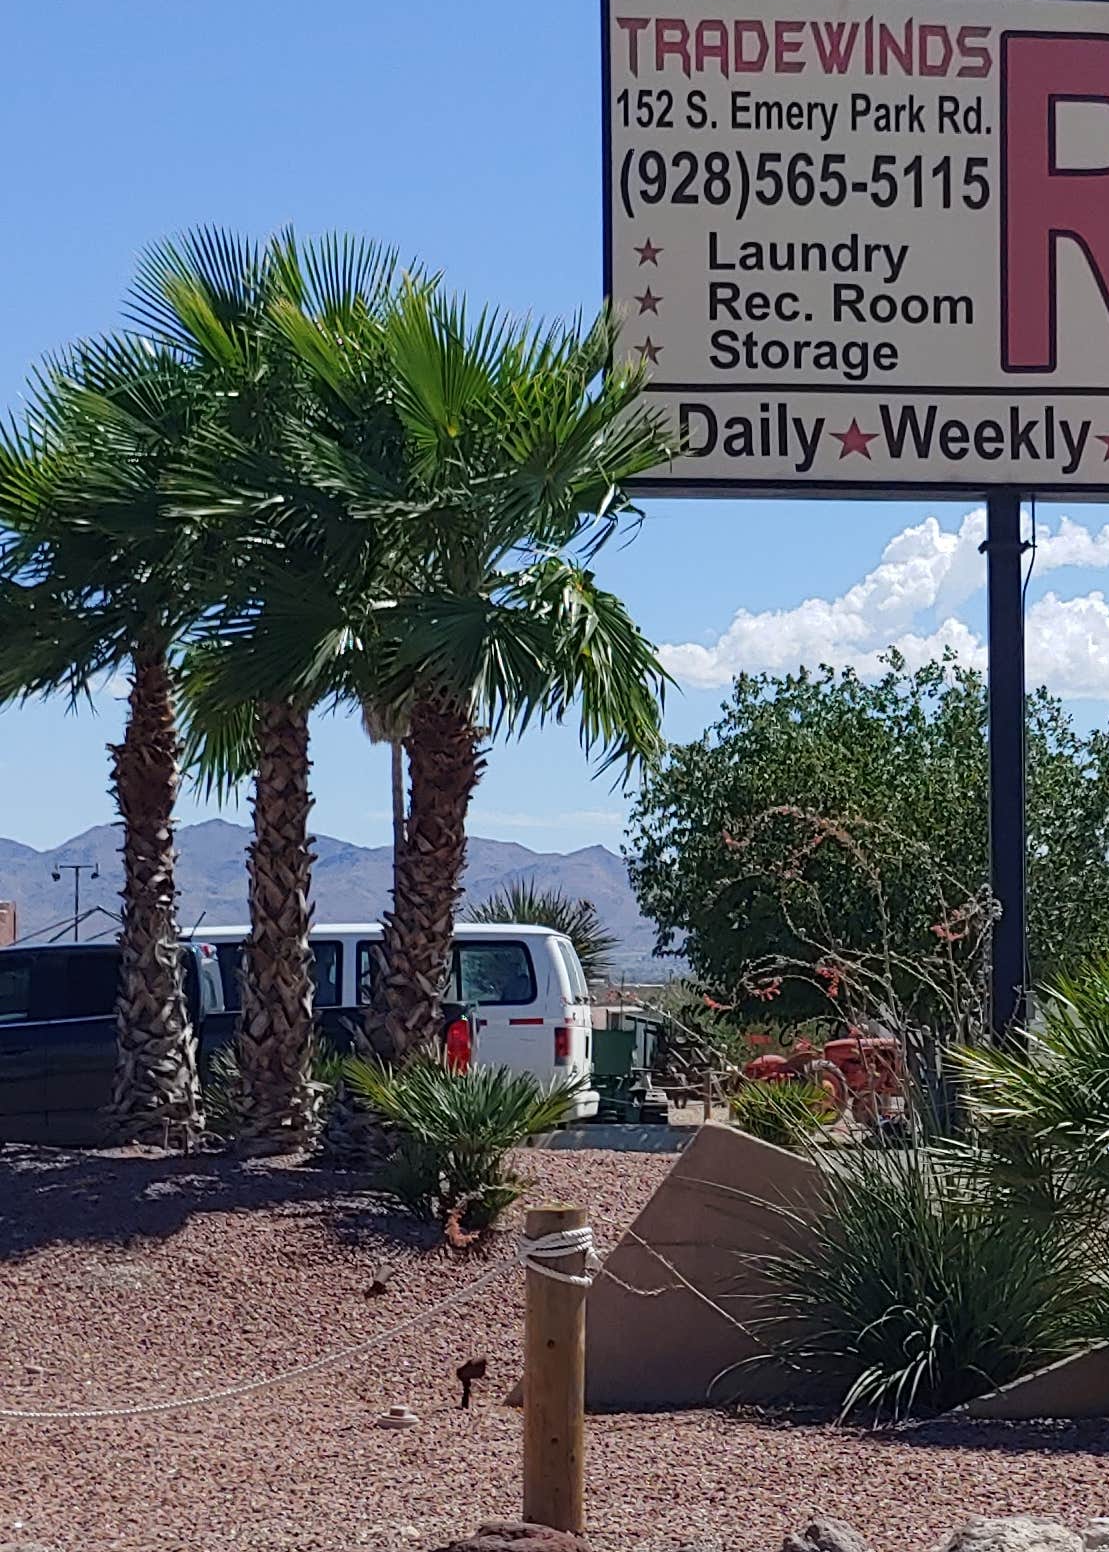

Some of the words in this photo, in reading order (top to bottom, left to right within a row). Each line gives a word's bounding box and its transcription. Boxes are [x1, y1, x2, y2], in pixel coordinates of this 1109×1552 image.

[615, 15, 992, 79] TRADEWINDS
[617, 89, 674, 129] 152
[686, 90, 718, 130] S.
[731, 91, 837, 140] Emery
[851, 94, 926, 134] Park
[937, 96, 992, 136] Rd.
[620, 149, 990, 218] (928)565-5115
[708, 231, 908, 283] Laundry
[709, 281, 813, 323] Rec.
[833, 283, 974, 325] Room
[709, 330, 898, 380] Storage
[678, 403, 825, 472] Daily
[880, 405, 1091, 474] Weekly
